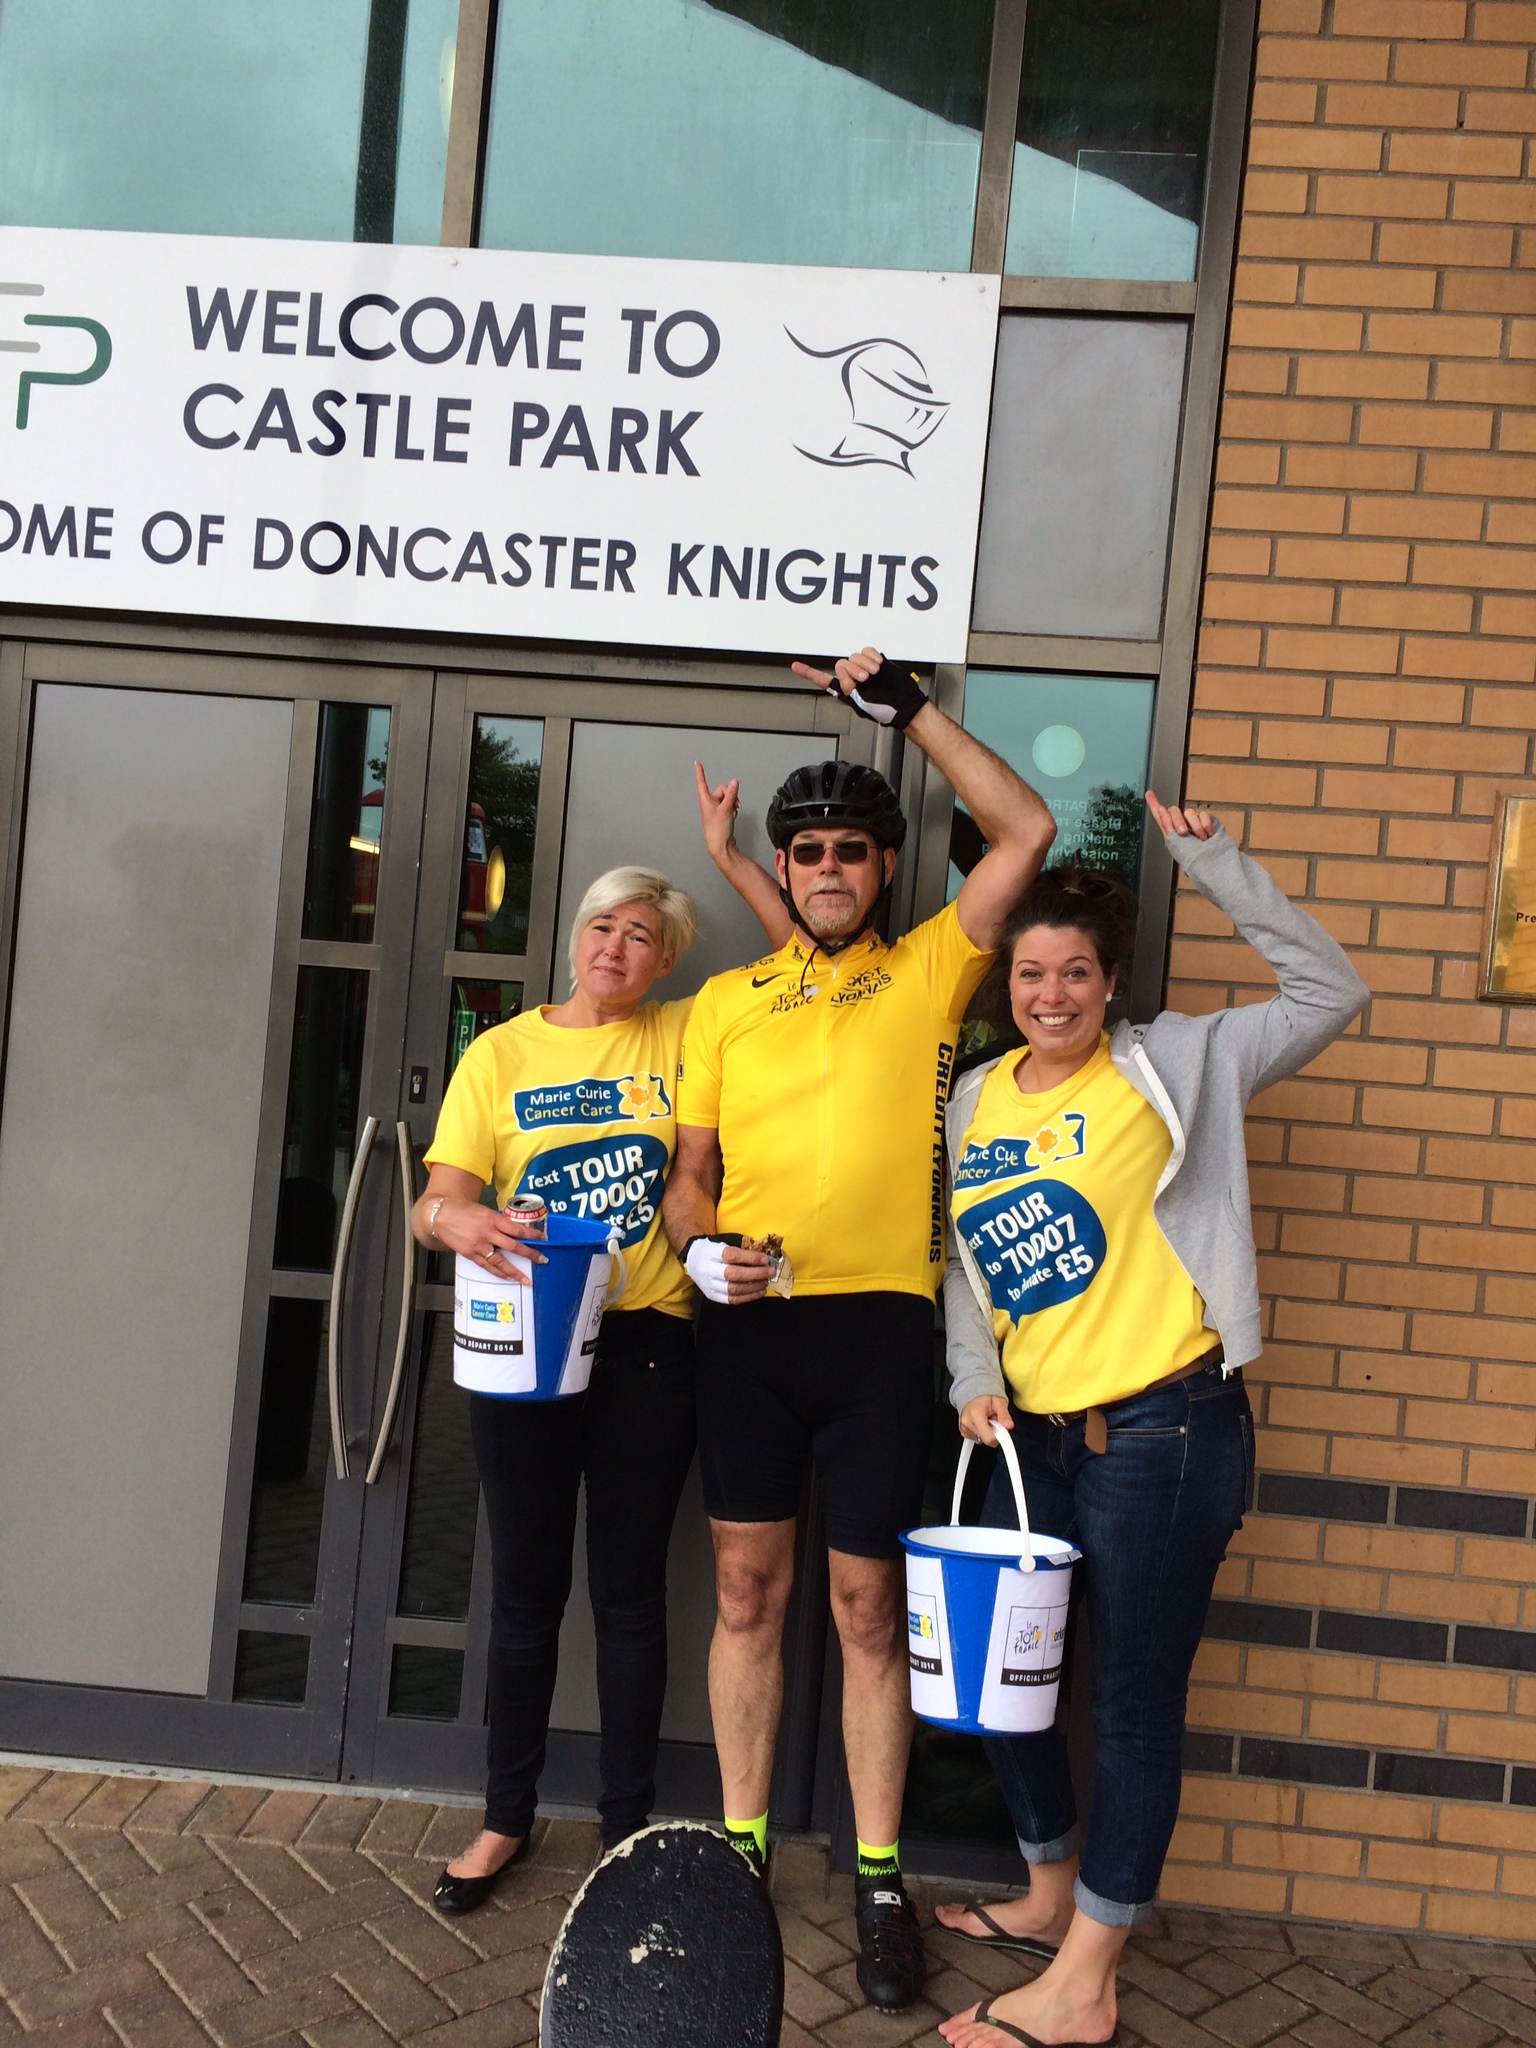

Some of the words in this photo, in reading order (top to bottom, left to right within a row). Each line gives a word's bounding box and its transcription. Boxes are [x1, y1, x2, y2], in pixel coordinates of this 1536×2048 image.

[186, 286, 586, 370] WELCOME
[620, 308, 720, 378] TO
[183, 383, 472, 463] CASTLE
[509, 402, 704, 477] PARK
[141, 510, 225, 566] OF
[253, 517, 637, 593] DONCASTER
[667, 543, 940, 611] KNIGHTS
[525, 1105, 575, 1122] Cancer
[580, 1102, 613, 1117] Care
[530, 1090, 571, 1106] Marie
[576, 1085, 611, 1100] Curie
[527, 1170, 560, 1190] Text
[563, 1145, 644, 1189] TOUR
[550, 1199, 567, 1213] to
[571, 1169, 659, 1219] 70007
[626, 1197, 655, 1230] £5
[929, 1142, 943, 1263] LYONNAIS
[980, 1191, 1053, 1248] TOUR
[985, 1261, 1002, 1275] to
[1000, 1213, 1076, 1276] 70007
[1007, 1288, 1021, 1301] to
[1055, 1244, 1095, 1283] £5
[494, 1344, 514, 1352] 2014
[1009, 1674, 1041, 1682] OFFICIAL
